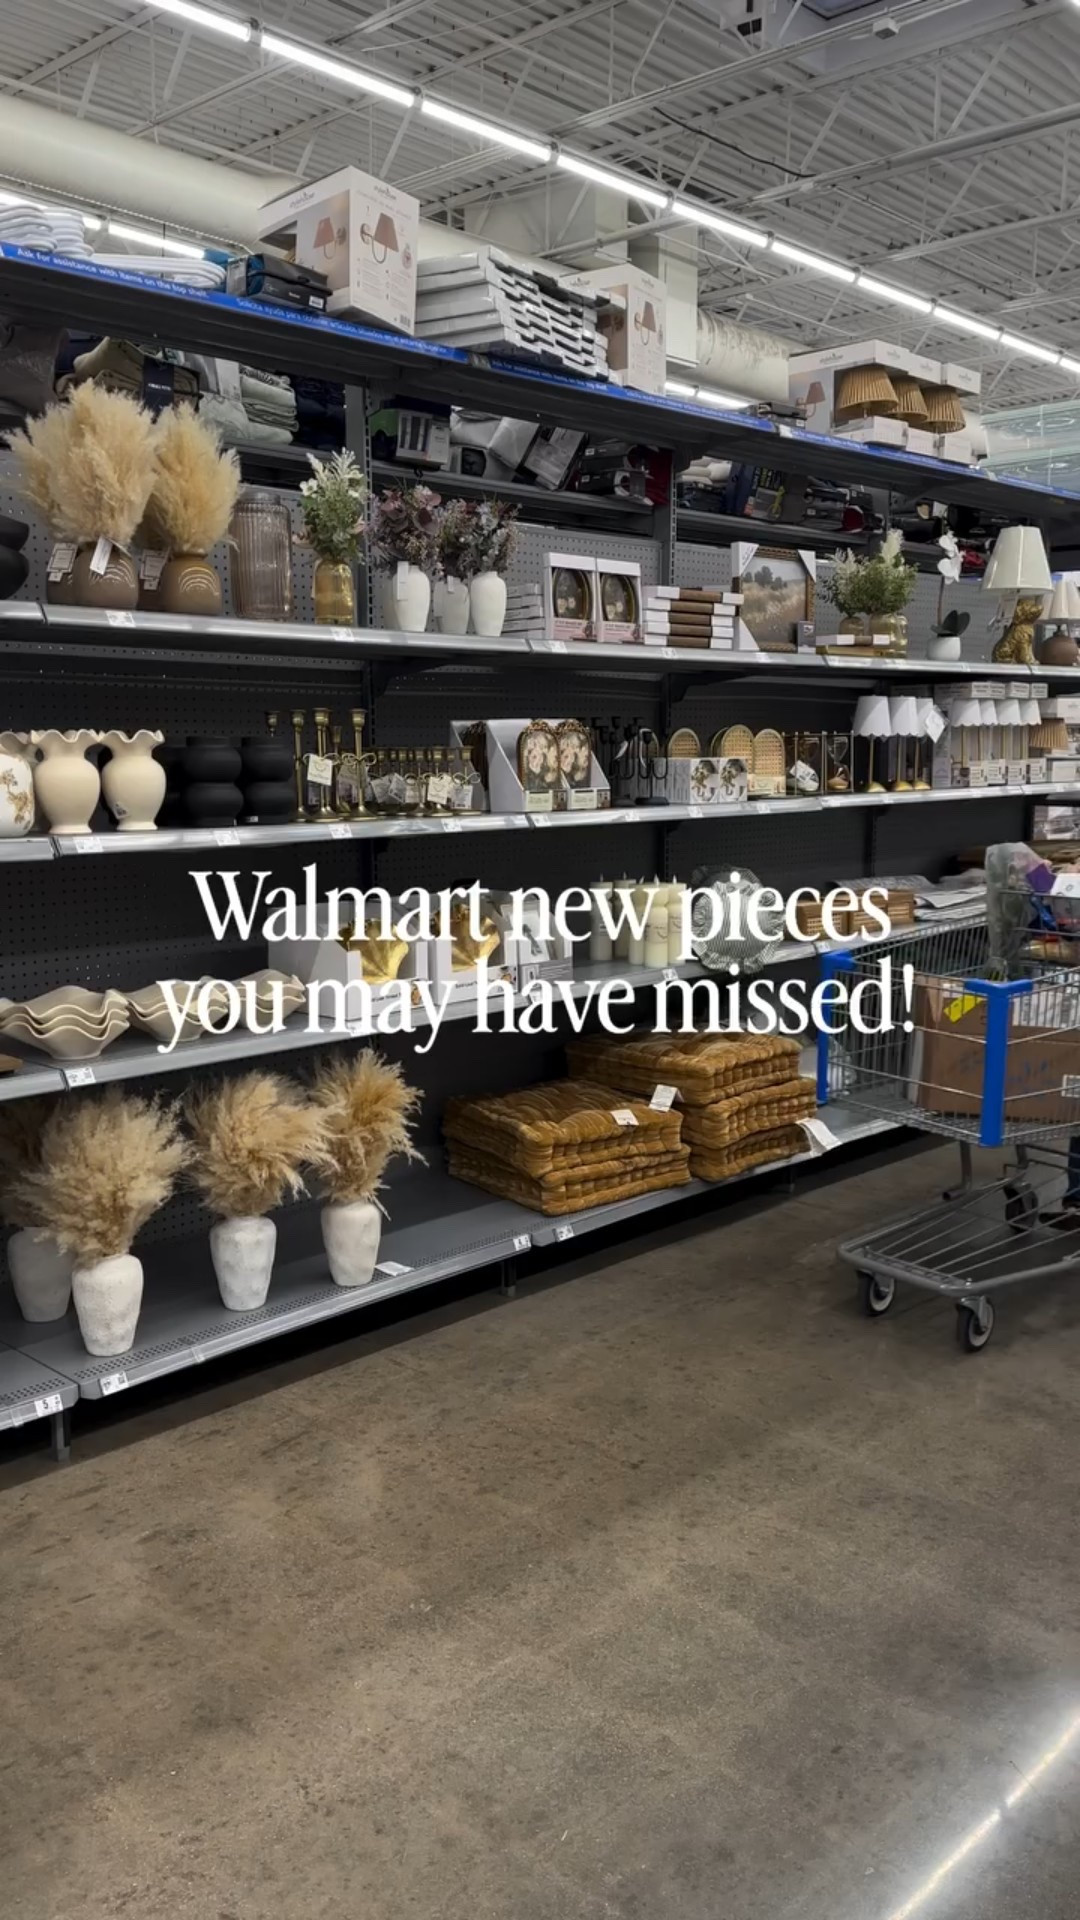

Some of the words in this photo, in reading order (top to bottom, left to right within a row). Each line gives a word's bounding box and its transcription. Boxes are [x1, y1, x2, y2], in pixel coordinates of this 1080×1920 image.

[17, 247, 35, 259] Ask
[36, 252, 51, 264] for
[53, 257, 97, 274] assistance
[99, 265, 119, 279] with
[119, 271, 144, 284] items
[144, 278, 157, 288] on
[157, 279, 171, 292] the
[172, 283, 187, 295] top
